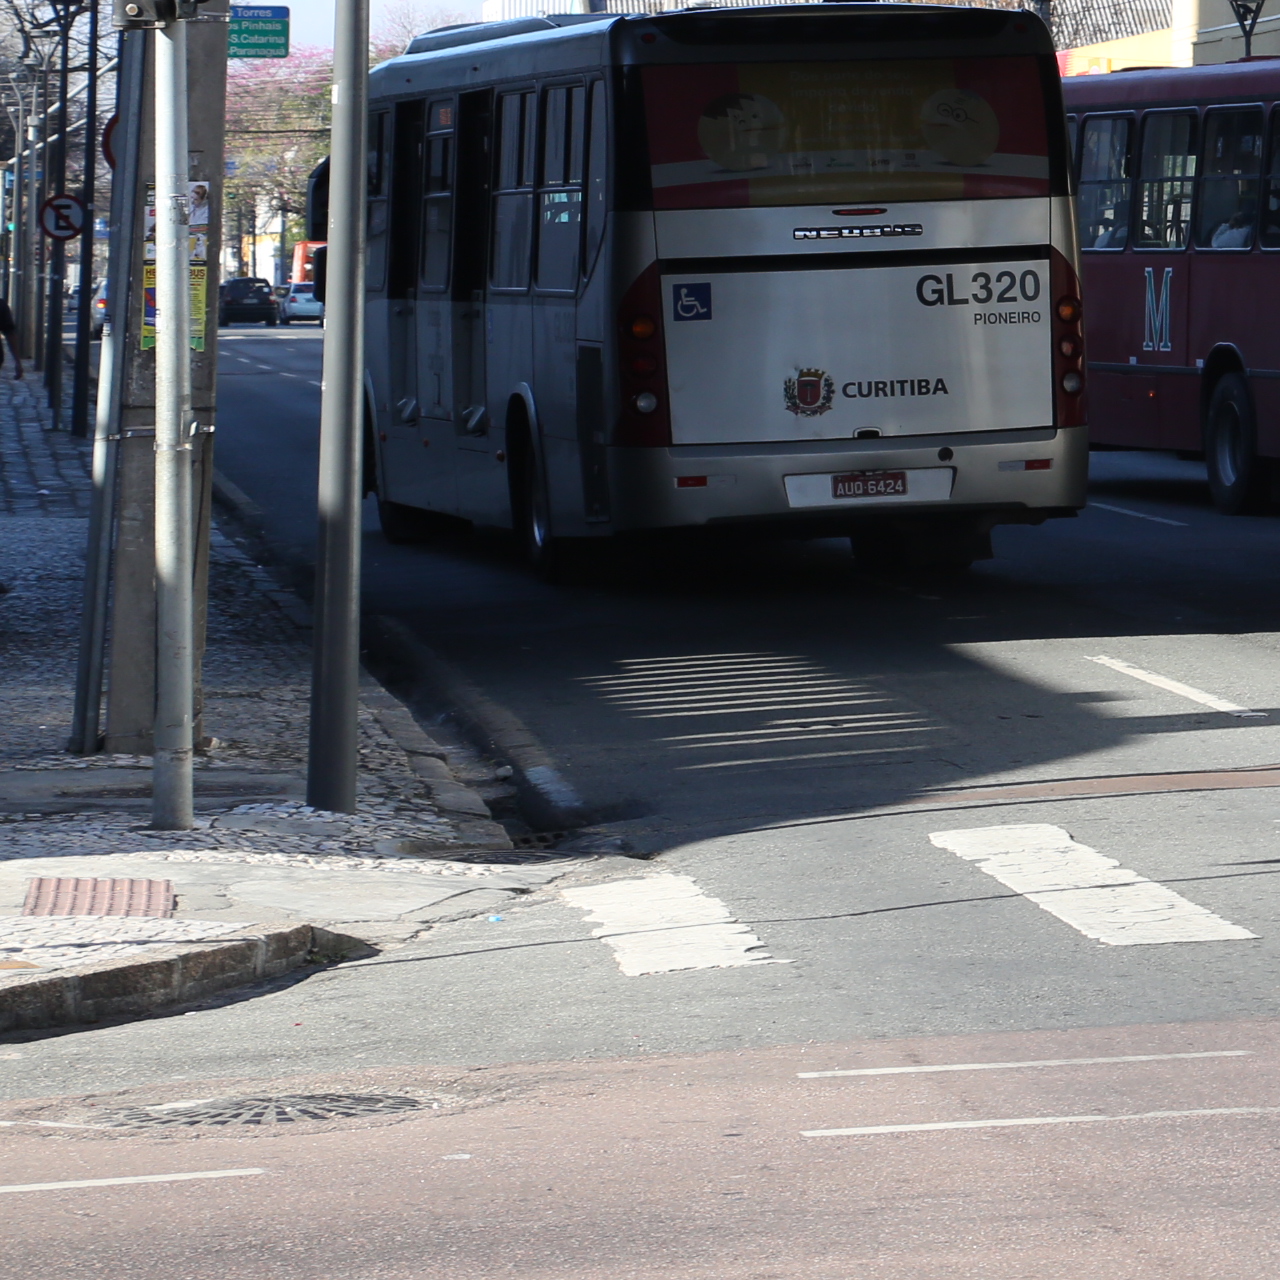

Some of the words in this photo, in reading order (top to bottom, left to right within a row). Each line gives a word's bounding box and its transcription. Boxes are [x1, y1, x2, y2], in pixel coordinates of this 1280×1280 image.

[236, 8, 272, 17] Torres
[242, 22, 282, 30] Pinhais
[916, 269, 1041, 307] GL320
[974, 311, 1041, 325] PIONEIRO
[842, 378, 948, 399] CURITIBA
